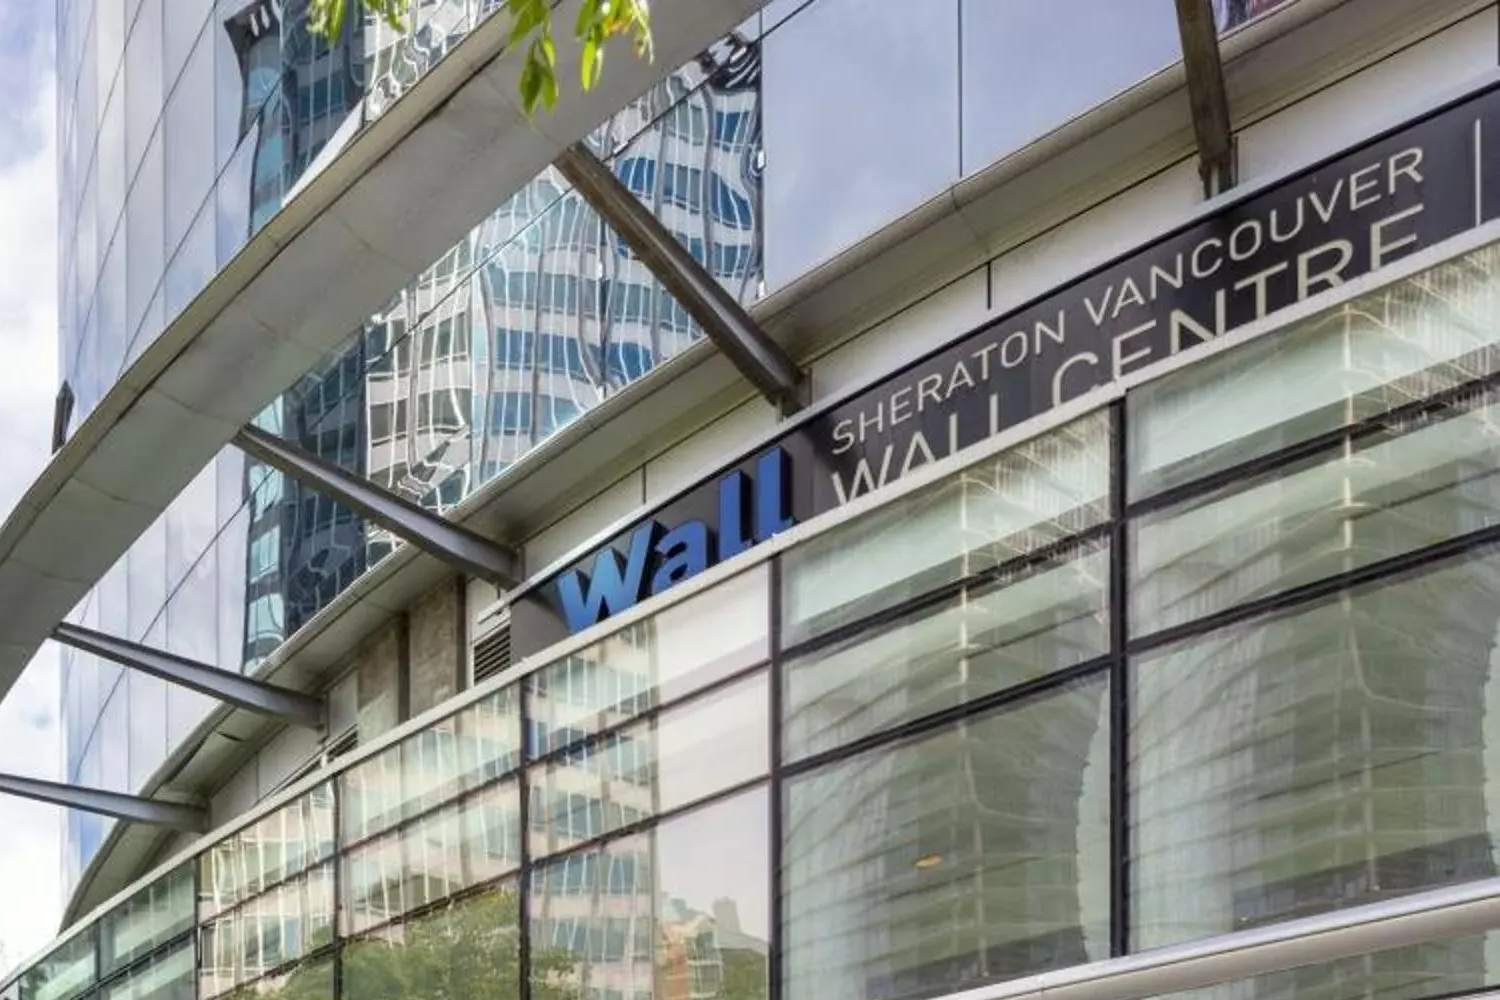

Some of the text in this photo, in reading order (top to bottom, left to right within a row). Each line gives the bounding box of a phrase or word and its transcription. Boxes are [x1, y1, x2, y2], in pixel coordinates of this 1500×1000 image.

[831, 146, 1426, 456] SHERATON VANCOUVER
[1052, 203, 1426, 409] CENTRE
[557, 447, 796, 636] Wall
